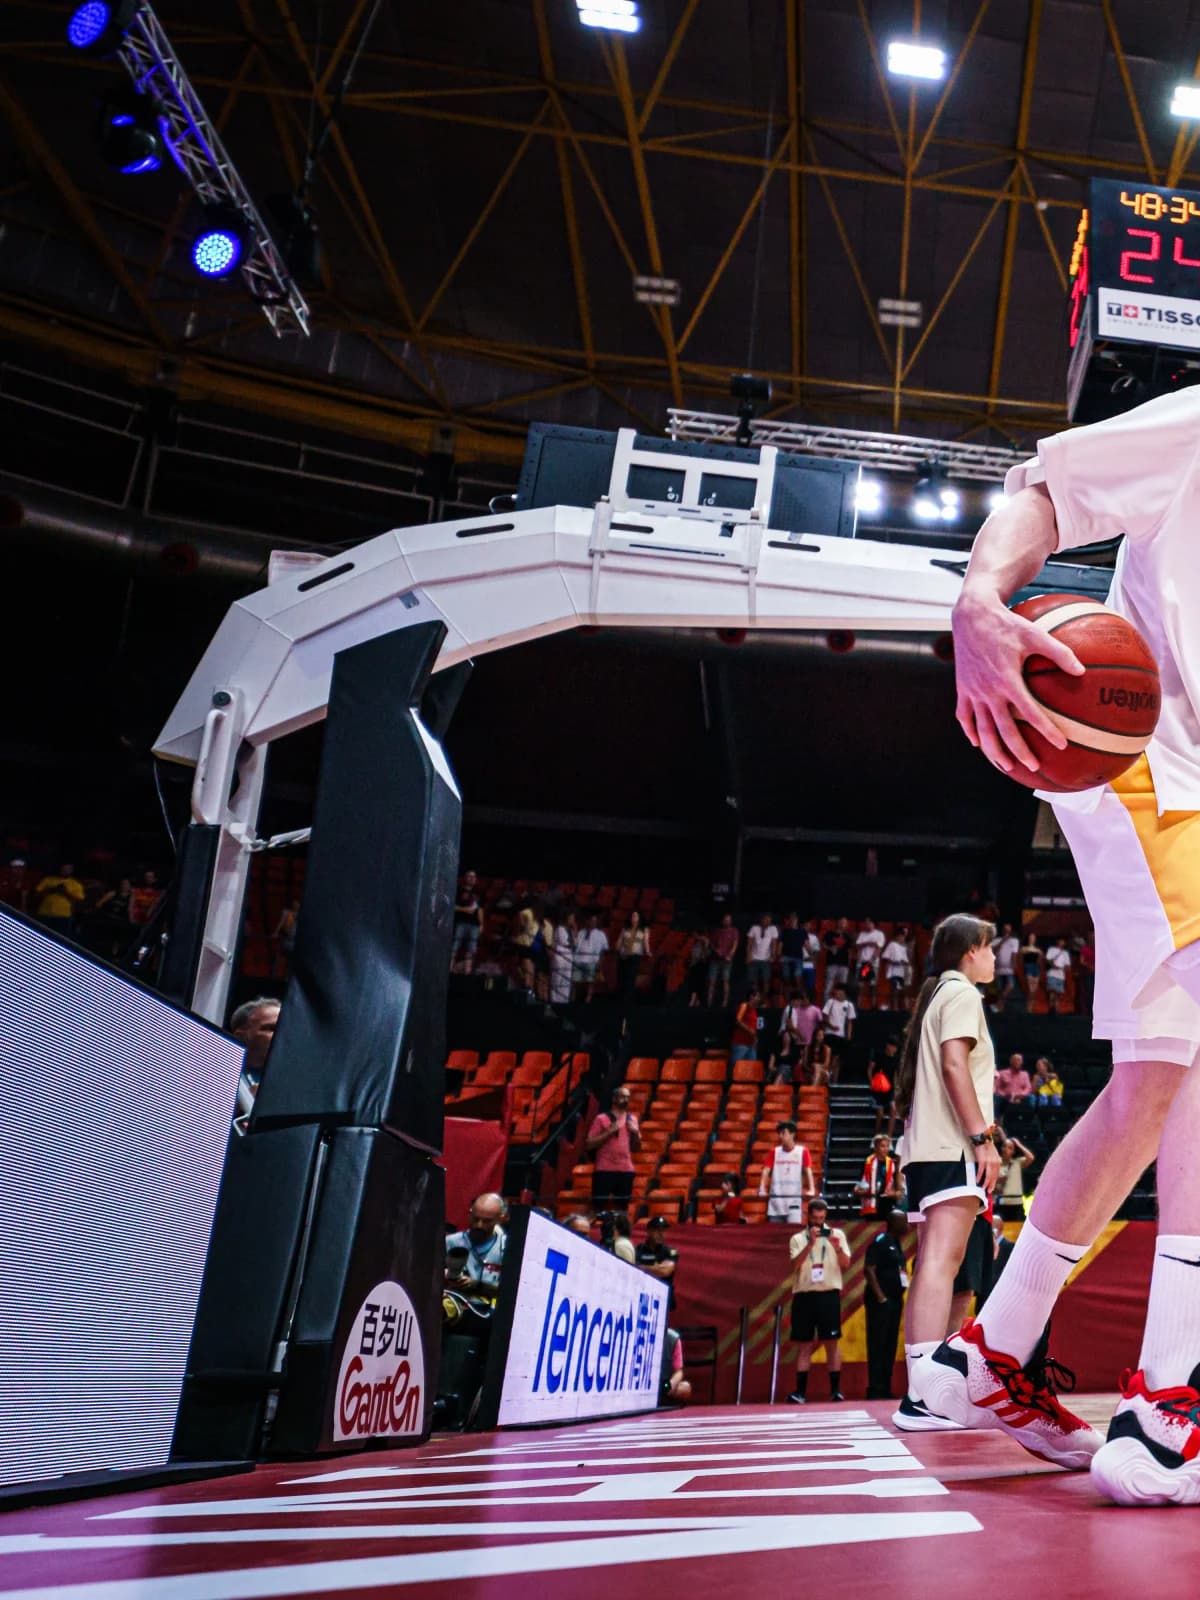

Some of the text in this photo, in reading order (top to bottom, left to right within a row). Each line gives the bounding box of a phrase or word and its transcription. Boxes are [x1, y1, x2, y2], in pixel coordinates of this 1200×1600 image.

[359, 1303, 414, 1357] 百岁山
[532, 1247, 634, 1394] Tencent
